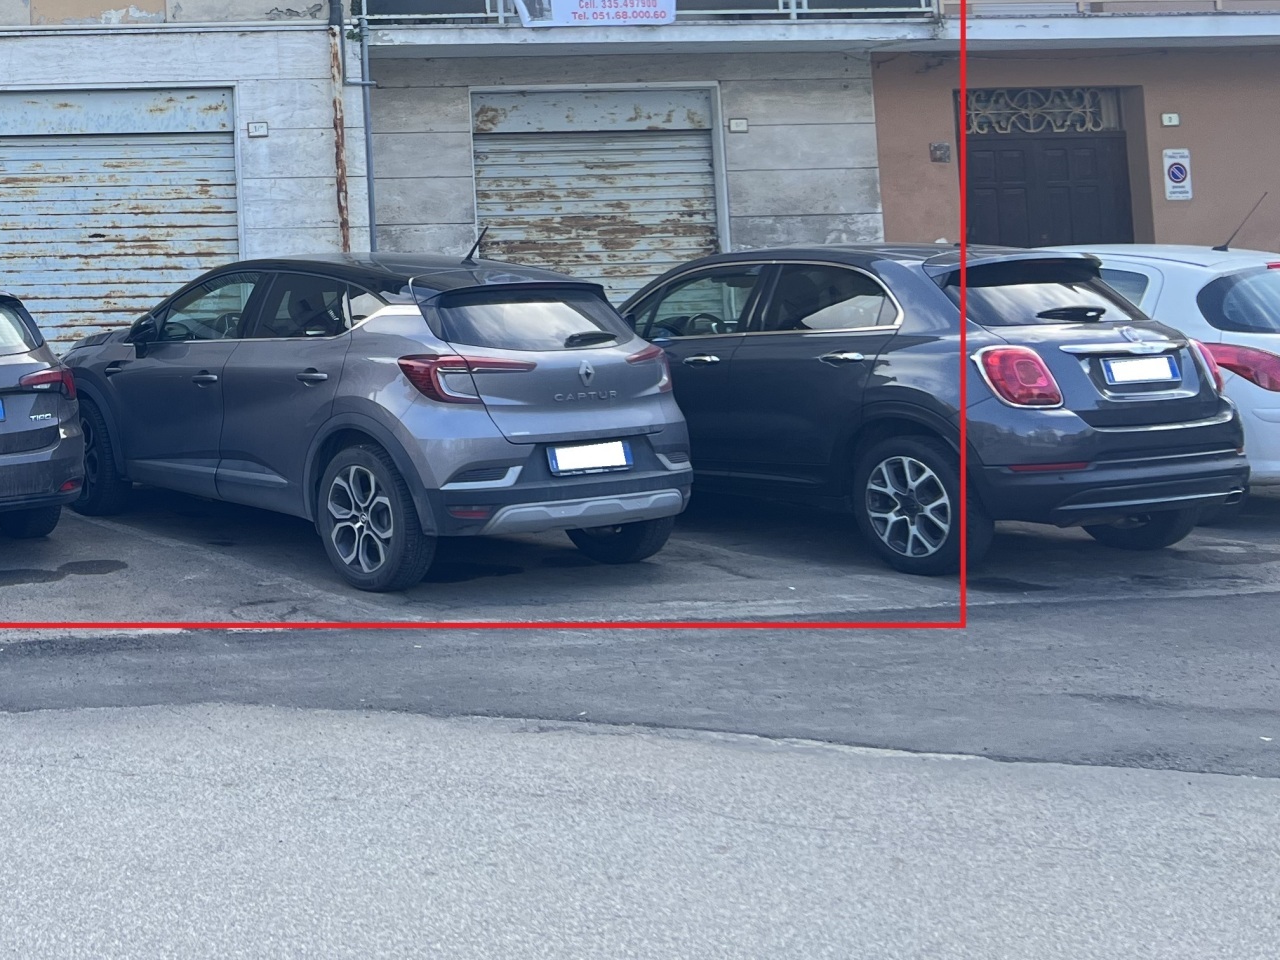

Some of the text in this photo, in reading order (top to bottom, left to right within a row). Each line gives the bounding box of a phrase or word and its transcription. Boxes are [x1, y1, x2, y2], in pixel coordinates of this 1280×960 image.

[579, 0, 657, 8] Cell. 335.497900
[571, 10, 666, 20] Tel. 051.68.000.60
[554, 390, 617, 401] CAPTUR
